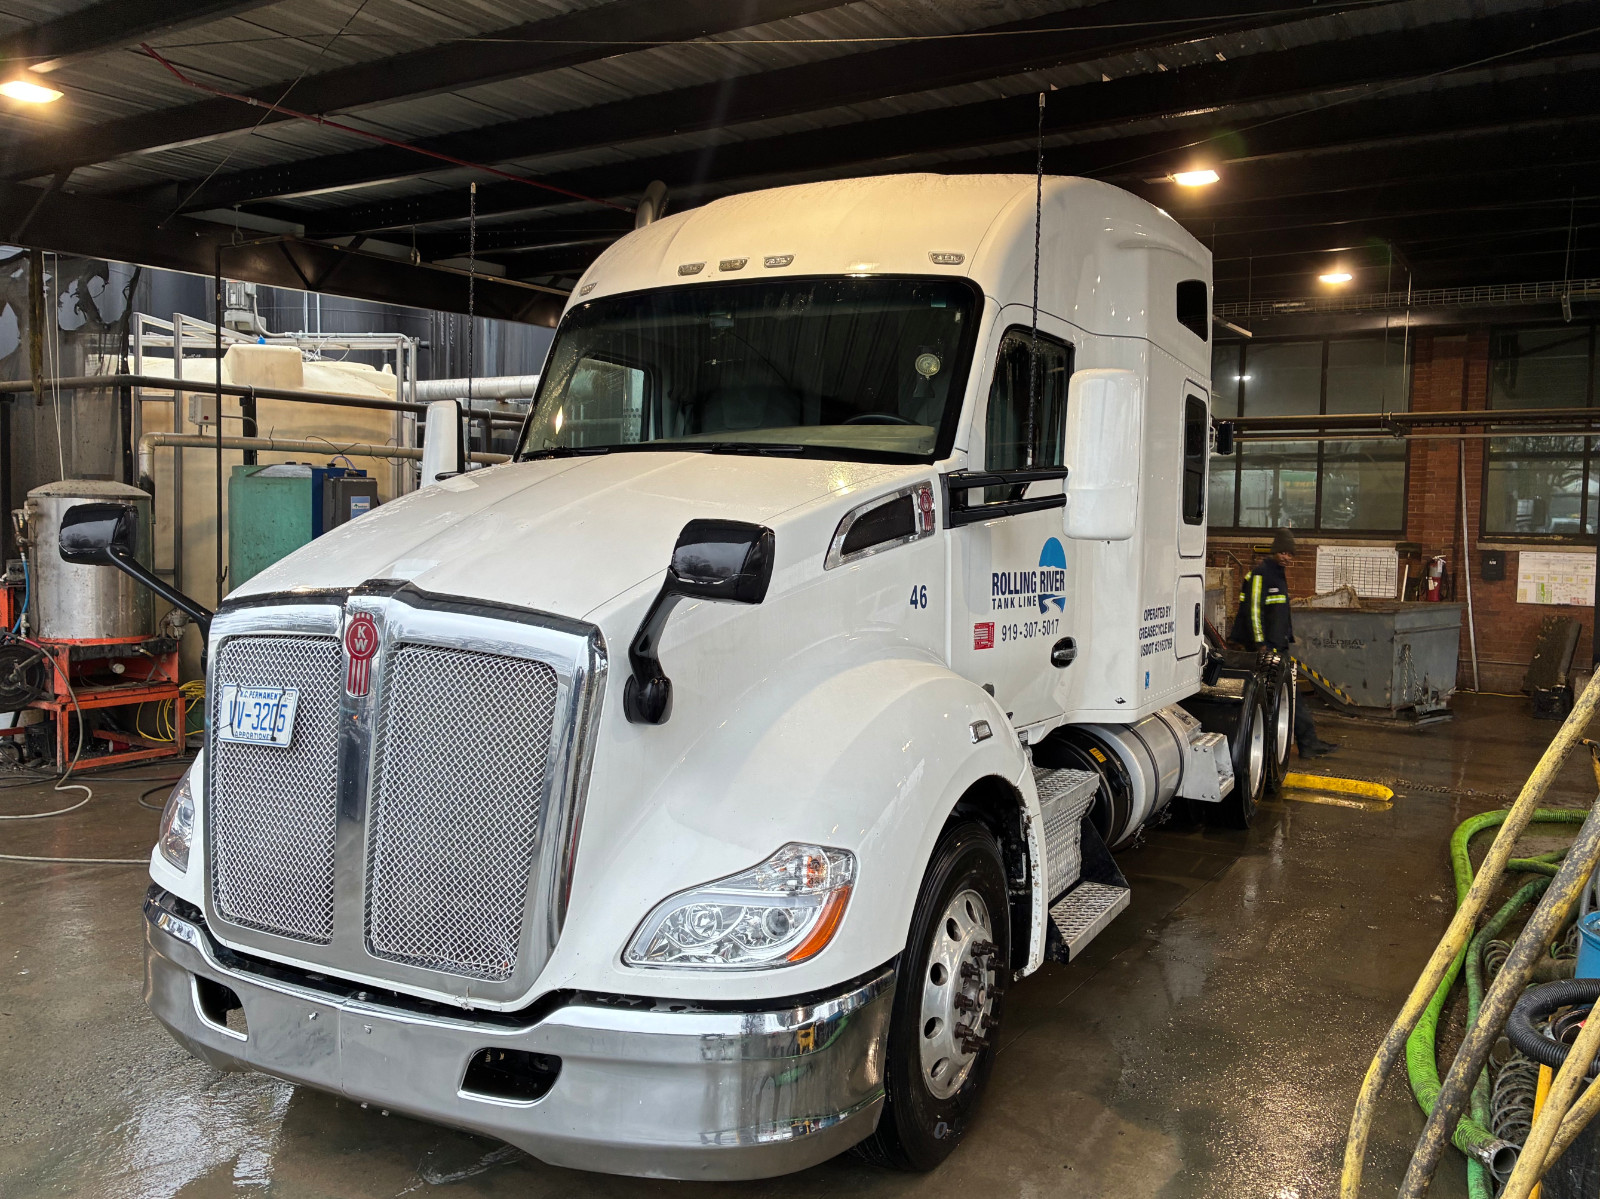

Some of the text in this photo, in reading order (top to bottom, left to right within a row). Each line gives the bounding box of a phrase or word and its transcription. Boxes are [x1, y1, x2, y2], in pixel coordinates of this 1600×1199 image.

[992, 570, 1065, 596] ROLLING RIVER
[909, 584, 928, 610] 46
[992, 595, 1037, 610] TANK LINE
[1144, 606, 1171, 621] OPERATED BY
[1001, 618, 1059, 642] 919-307-5017
[1139, 622, 1167, 640] GREASECYCLE
